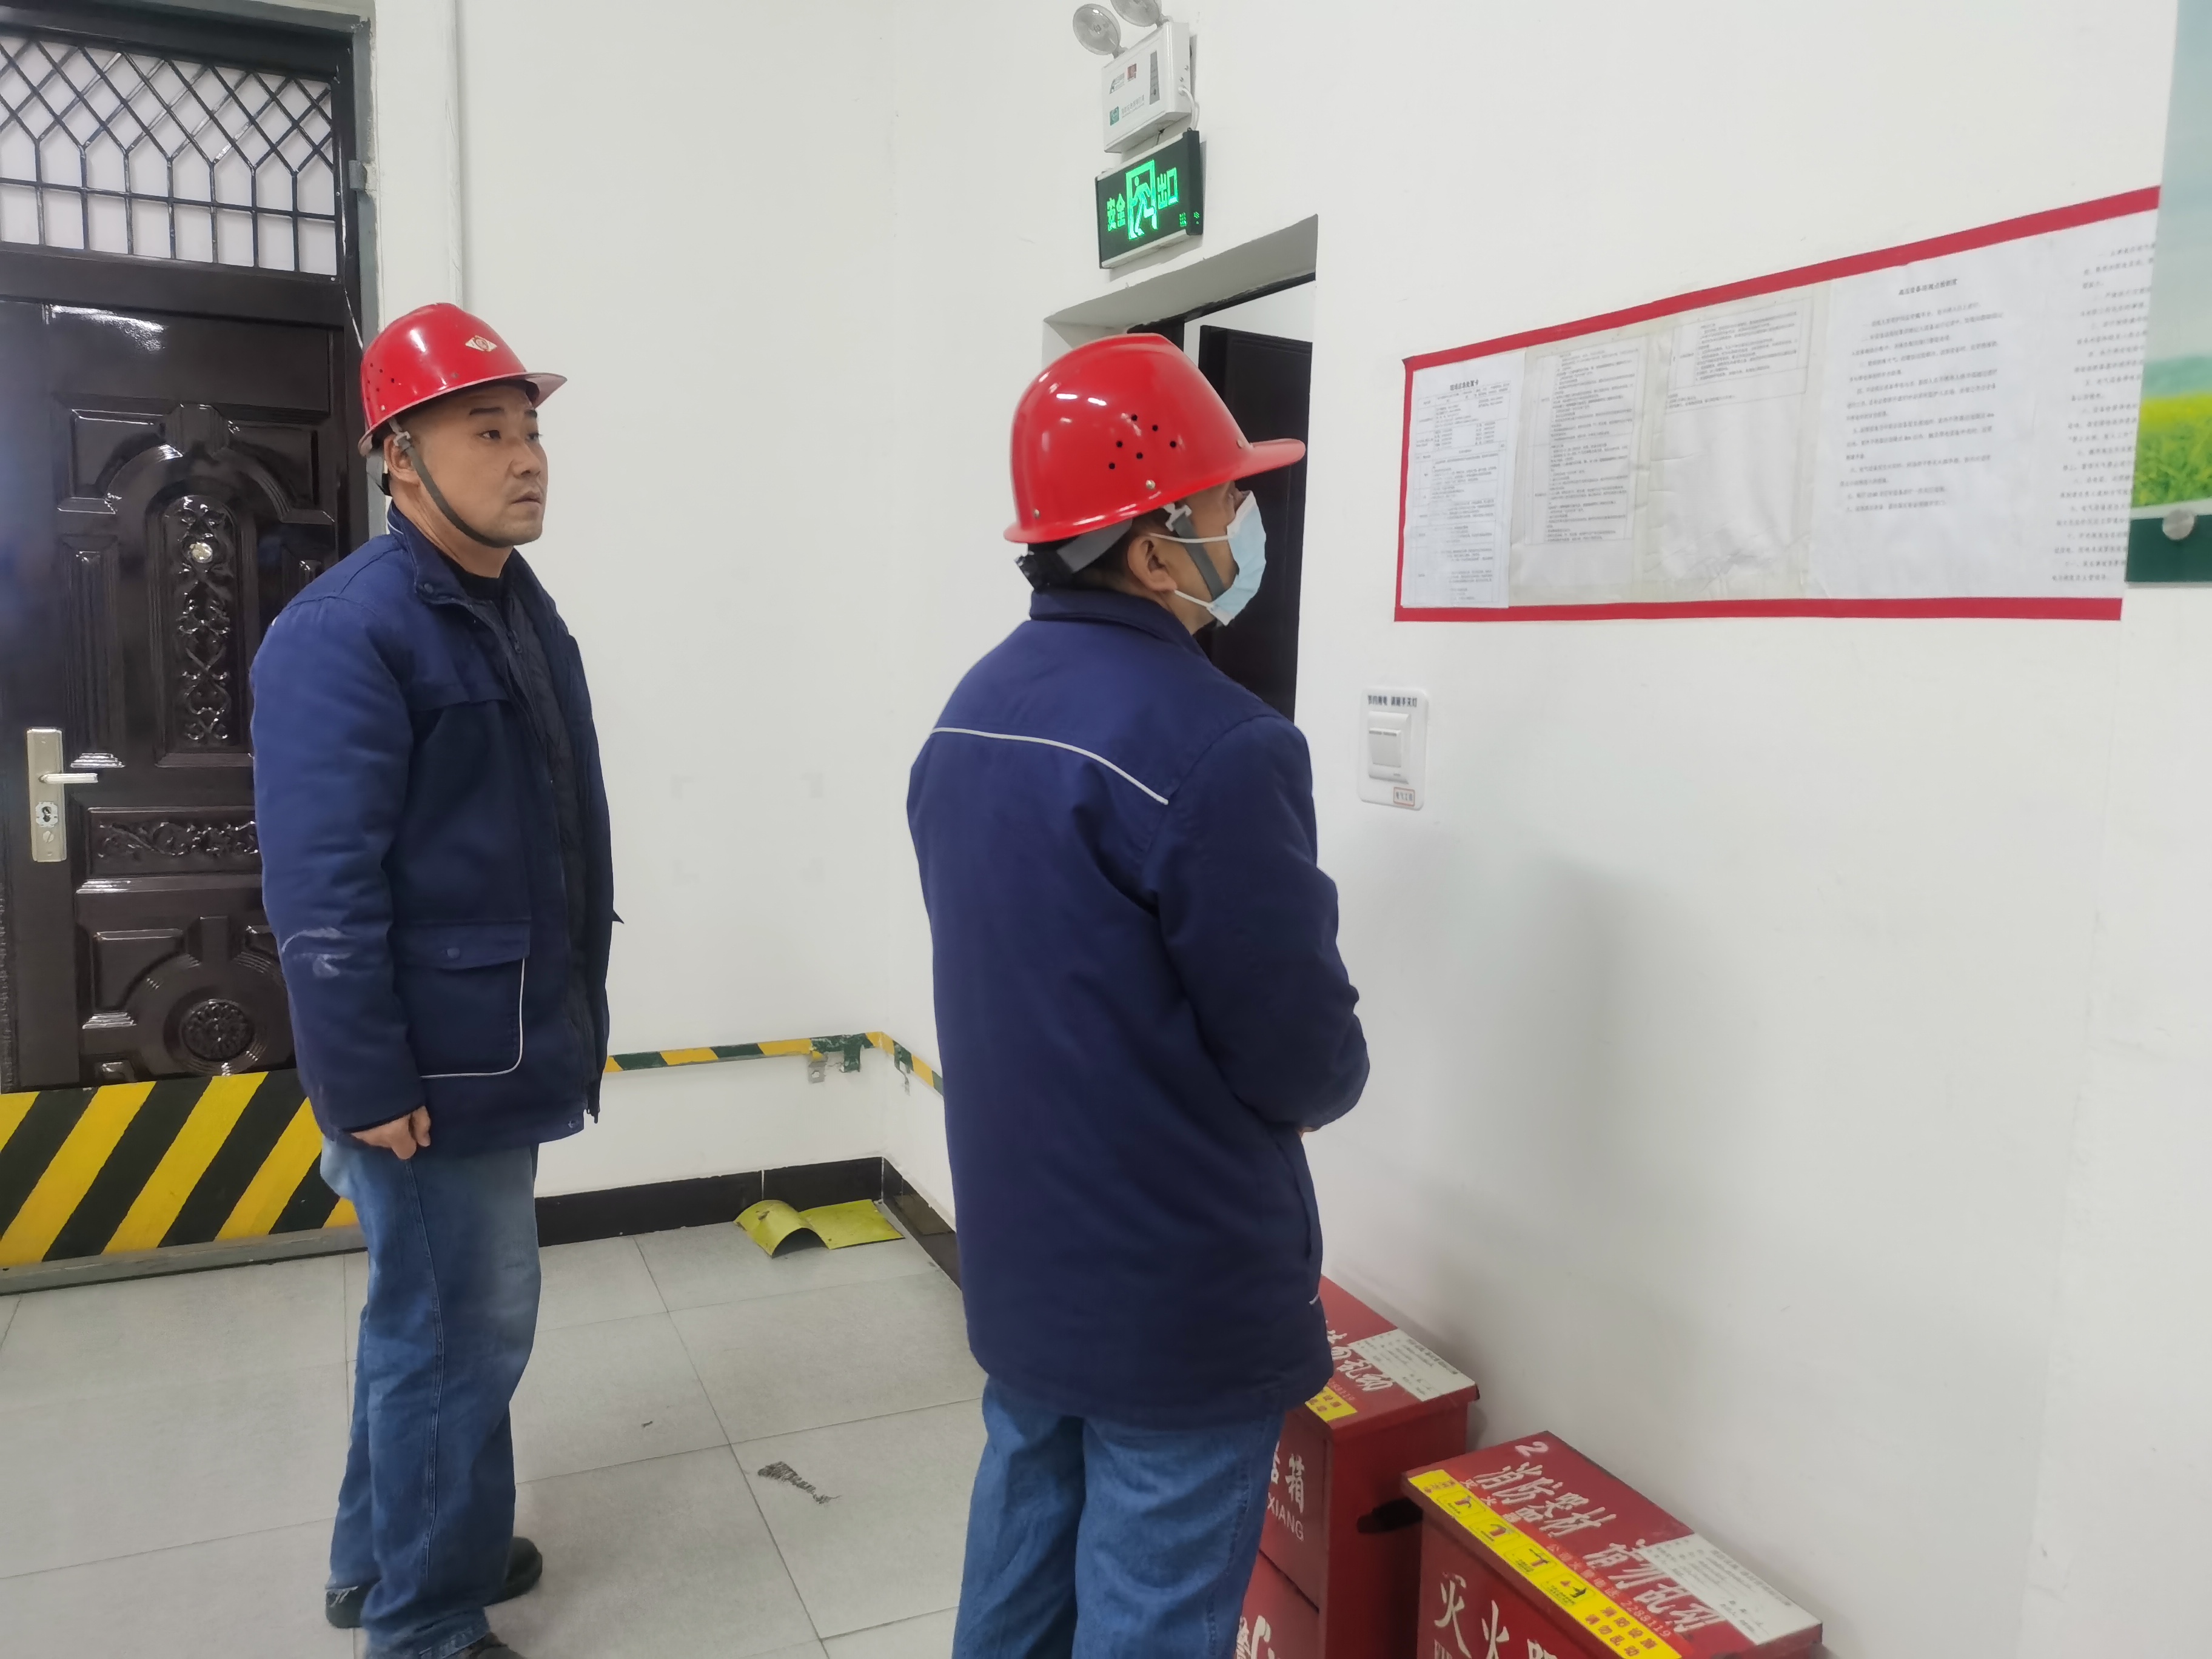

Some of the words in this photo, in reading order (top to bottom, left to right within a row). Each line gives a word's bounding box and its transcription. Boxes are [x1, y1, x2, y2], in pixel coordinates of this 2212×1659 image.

[1107, 193, 1126, 232] 安全
[1157, 167, 1179, 210] 出口
[1515, 1441, 1549, 1458] 2
[1267, 1492, 1304, 1541] XIANG
[1473, 1461, 1617, 1538] 消防器材
